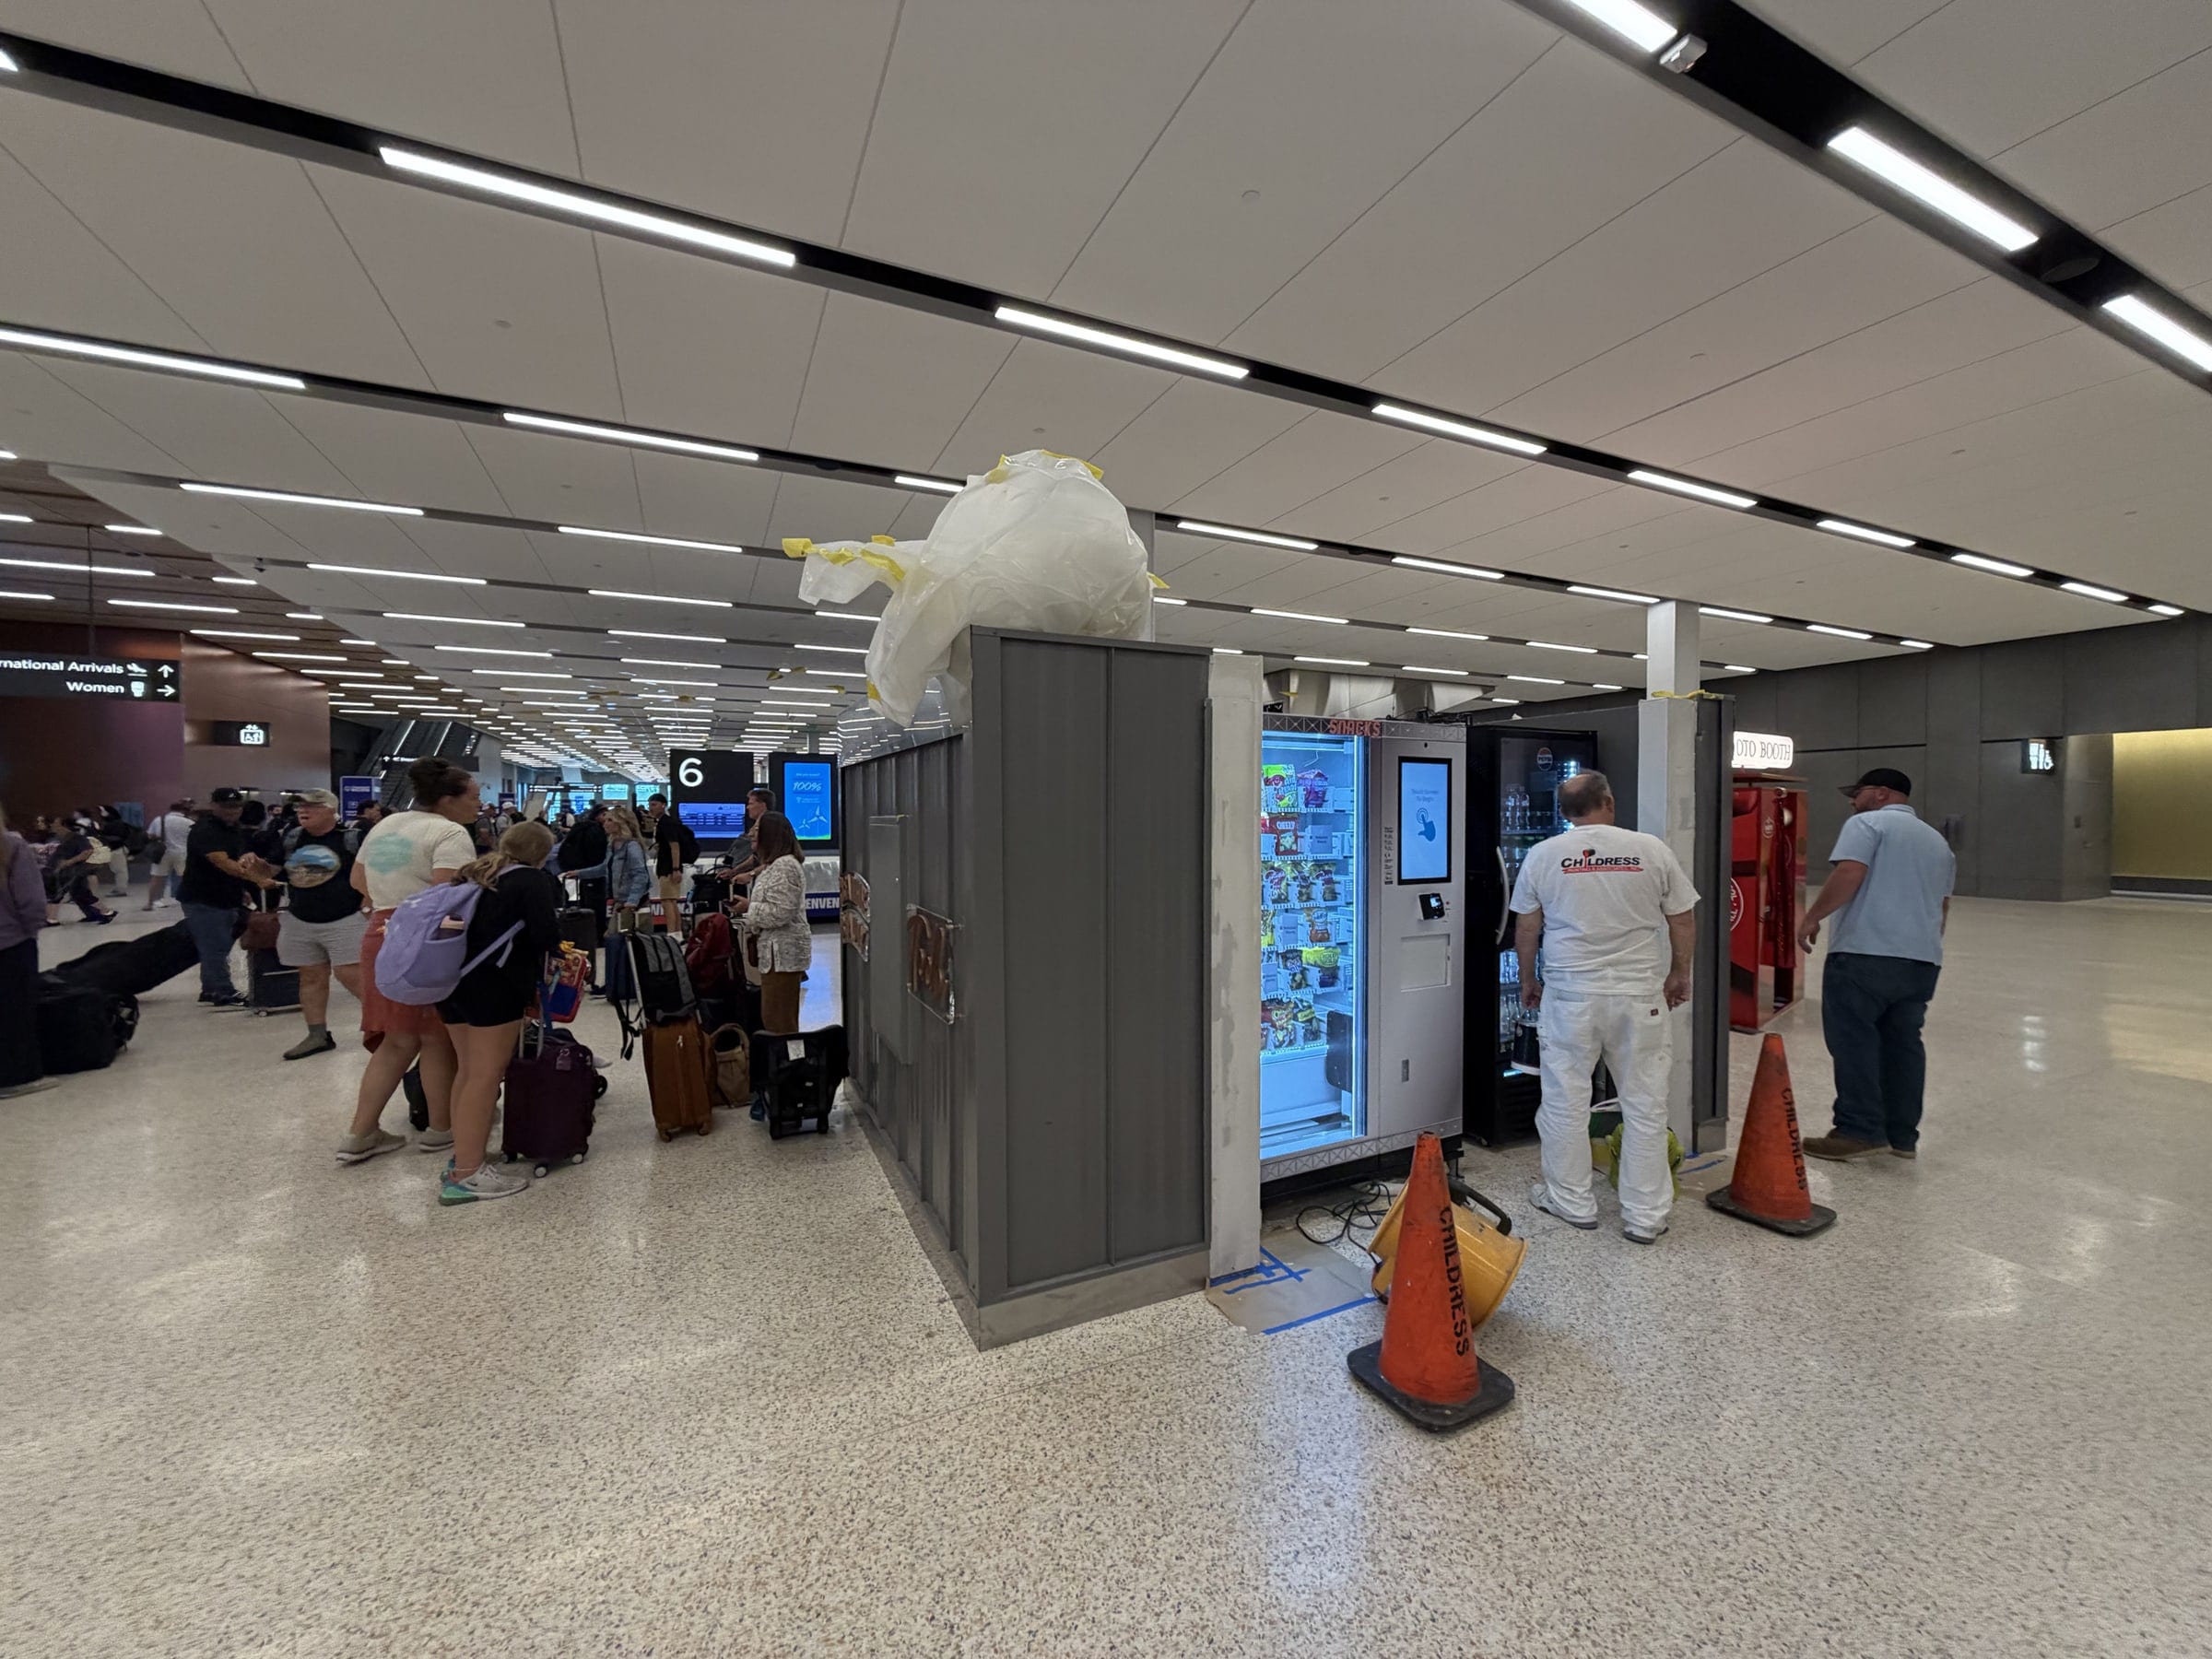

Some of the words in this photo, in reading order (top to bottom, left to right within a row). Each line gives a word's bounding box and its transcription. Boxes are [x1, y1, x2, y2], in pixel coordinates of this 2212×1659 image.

[67, 661, 124, 674] Arrivals
[65, 681, 124, 693] Women
[1329, 719, 1381, 736] SNACKS
[1759, 742, 1790, 760] BOOTH
[678, 757, 703, 787] 6
[793, 782, 822, 792] 100%
[1561, 853, 1641, 868] CHILDRESS
[1439, 1206, 1470, 1358] CHILDRESS
